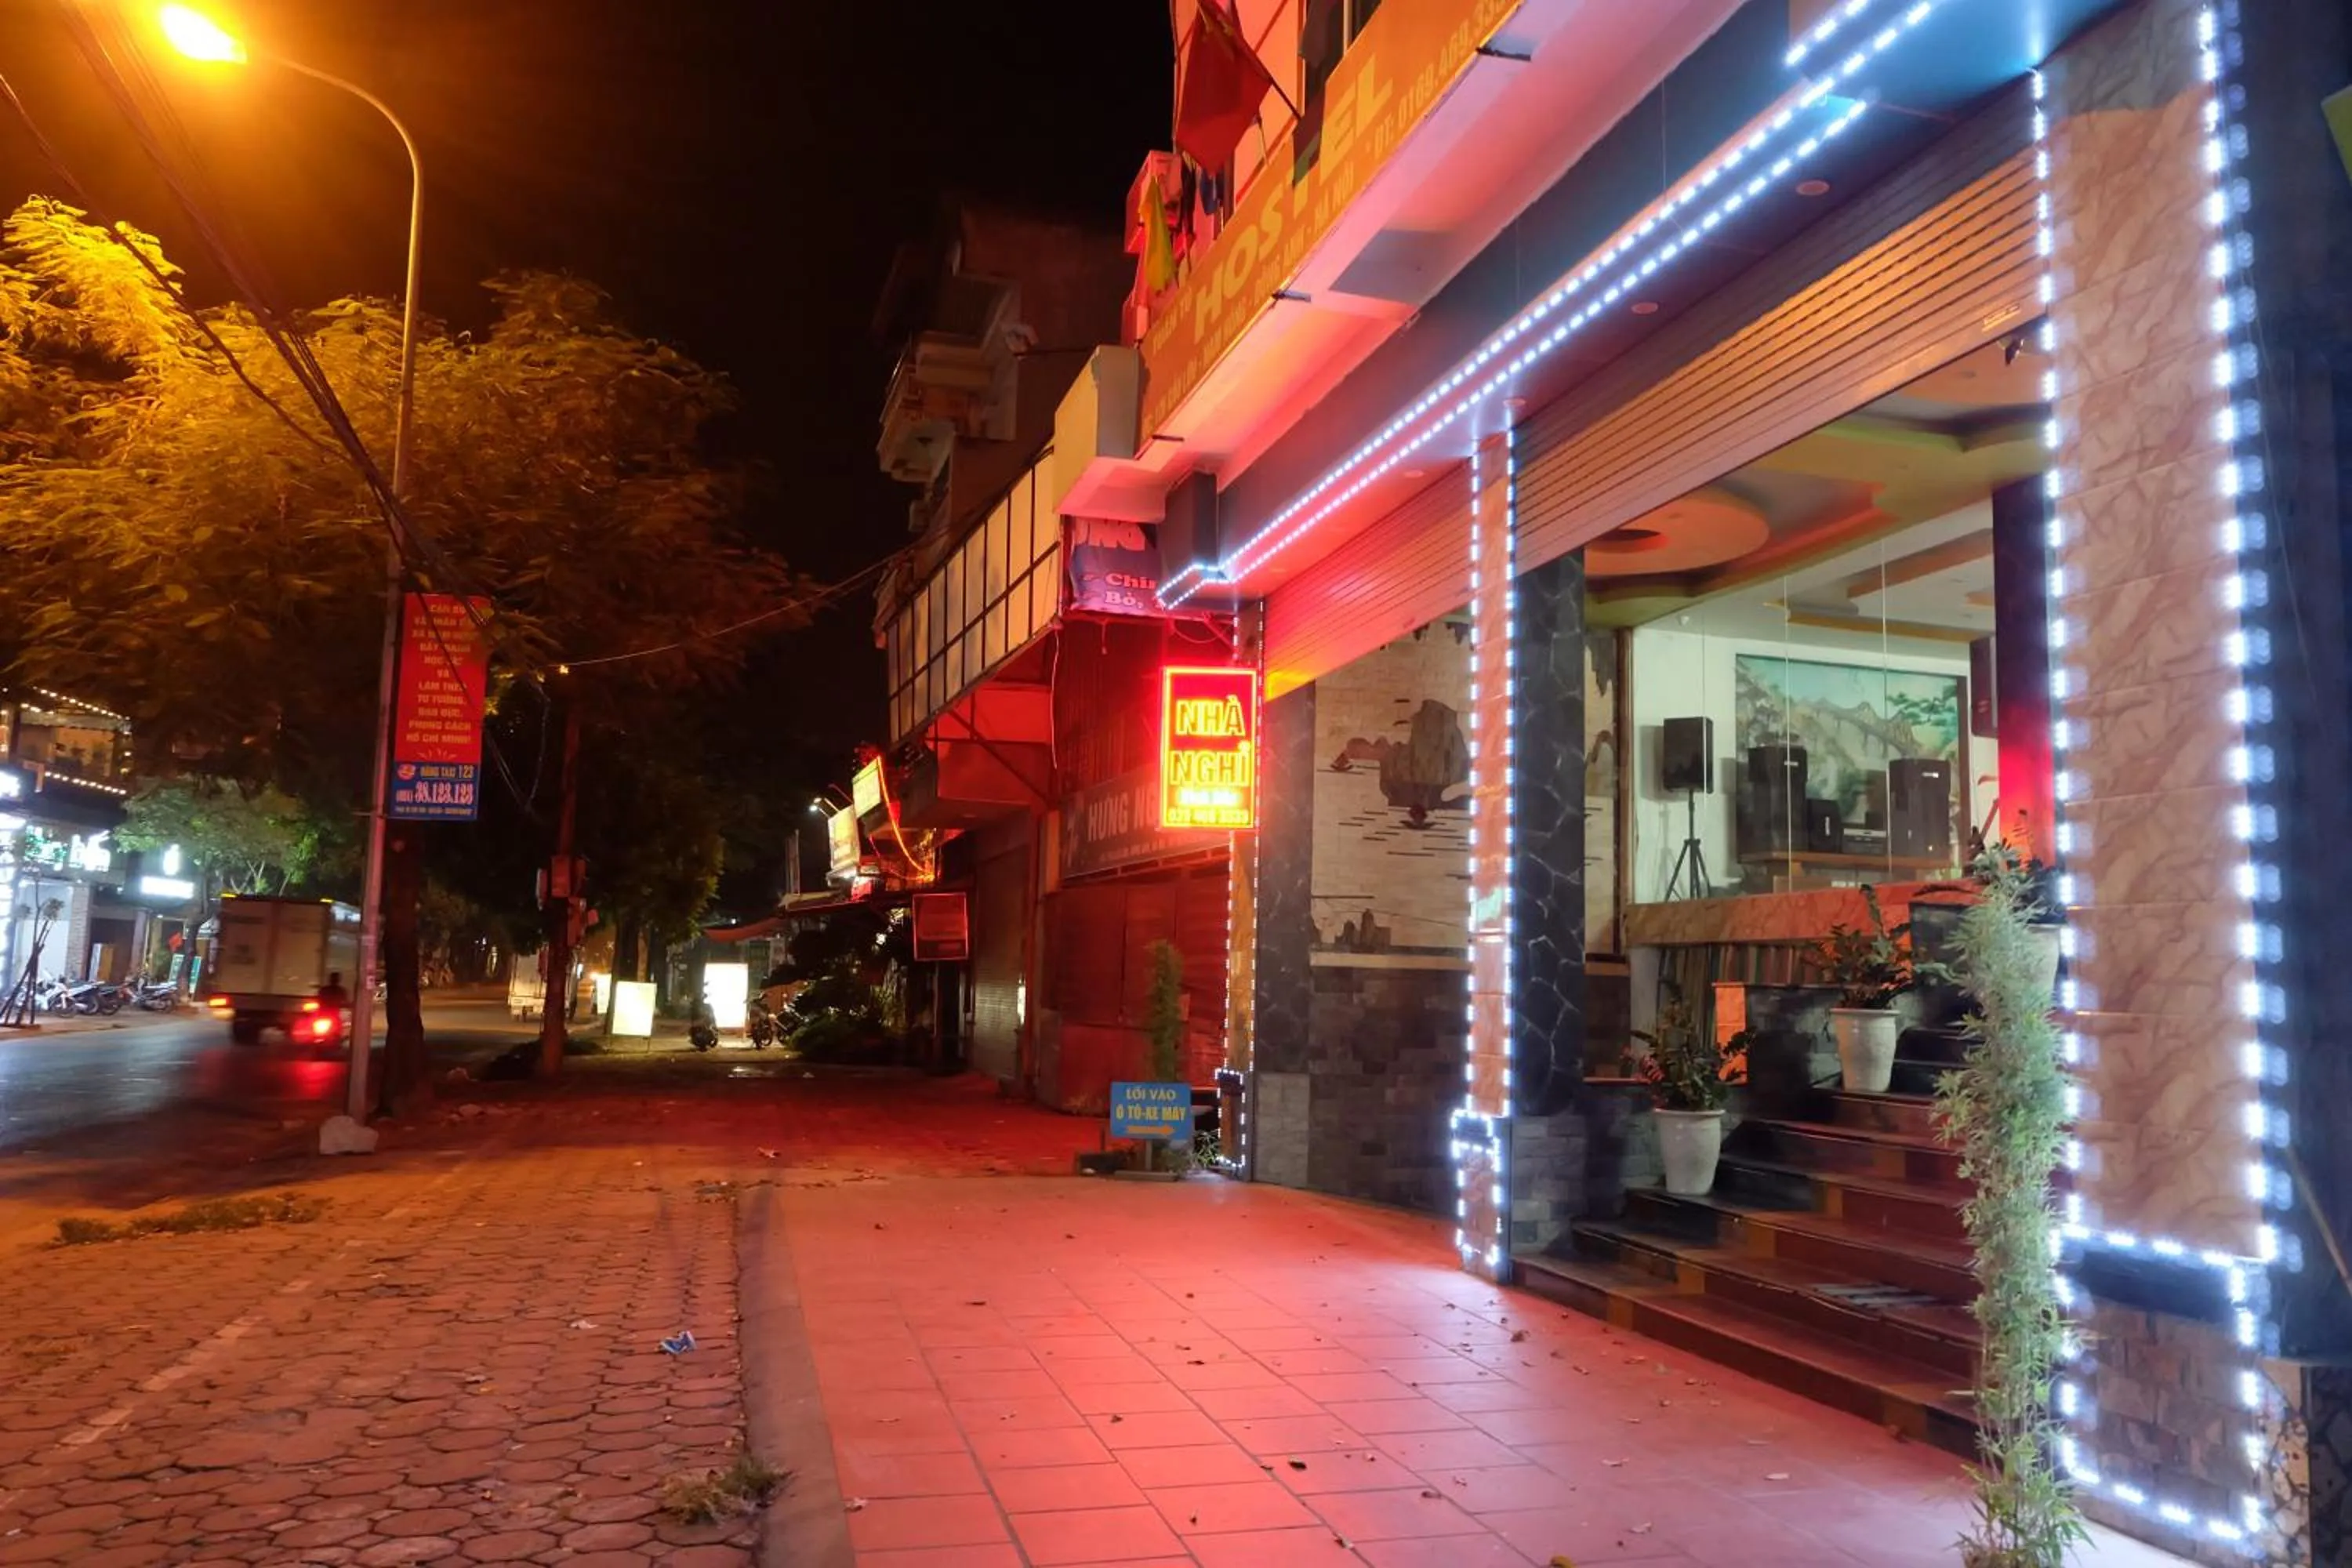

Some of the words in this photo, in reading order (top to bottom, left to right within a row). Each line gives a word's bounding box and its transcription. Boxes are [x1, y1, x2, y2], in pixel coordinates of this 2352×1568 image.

[1195, 52, 1393, 345] HOSTEL
[1175, 694, 1247, 737] NHÀ
[1170, 740, 1251, 787] NGHỈ
